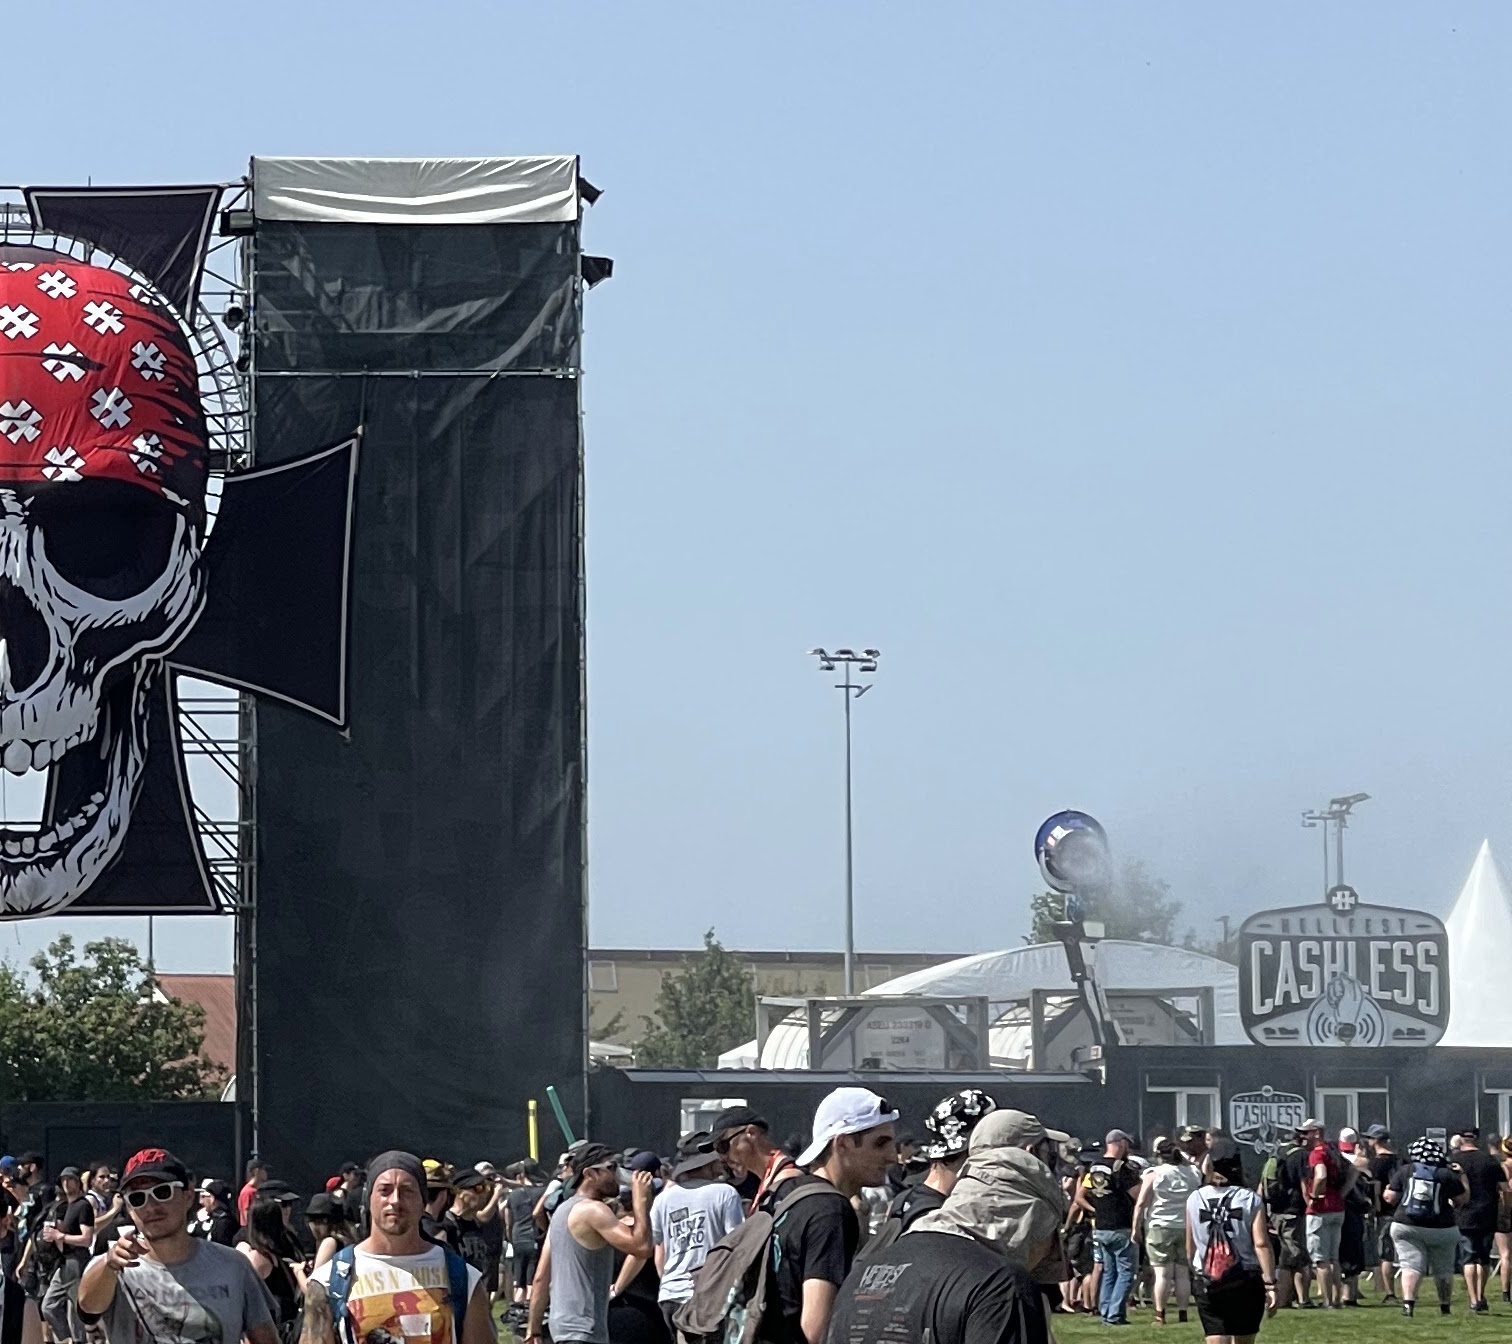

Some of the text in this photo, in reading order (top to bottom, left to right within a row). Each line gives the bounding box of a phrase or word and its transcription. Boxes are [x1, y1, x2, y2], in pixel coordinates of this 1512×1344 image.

[1281, 917, 1408, 934] HELLFEST
[1251, 940, 1439, 1016] CASHLESS
[1234, 1104, 1302, 1130] CASHLESS
